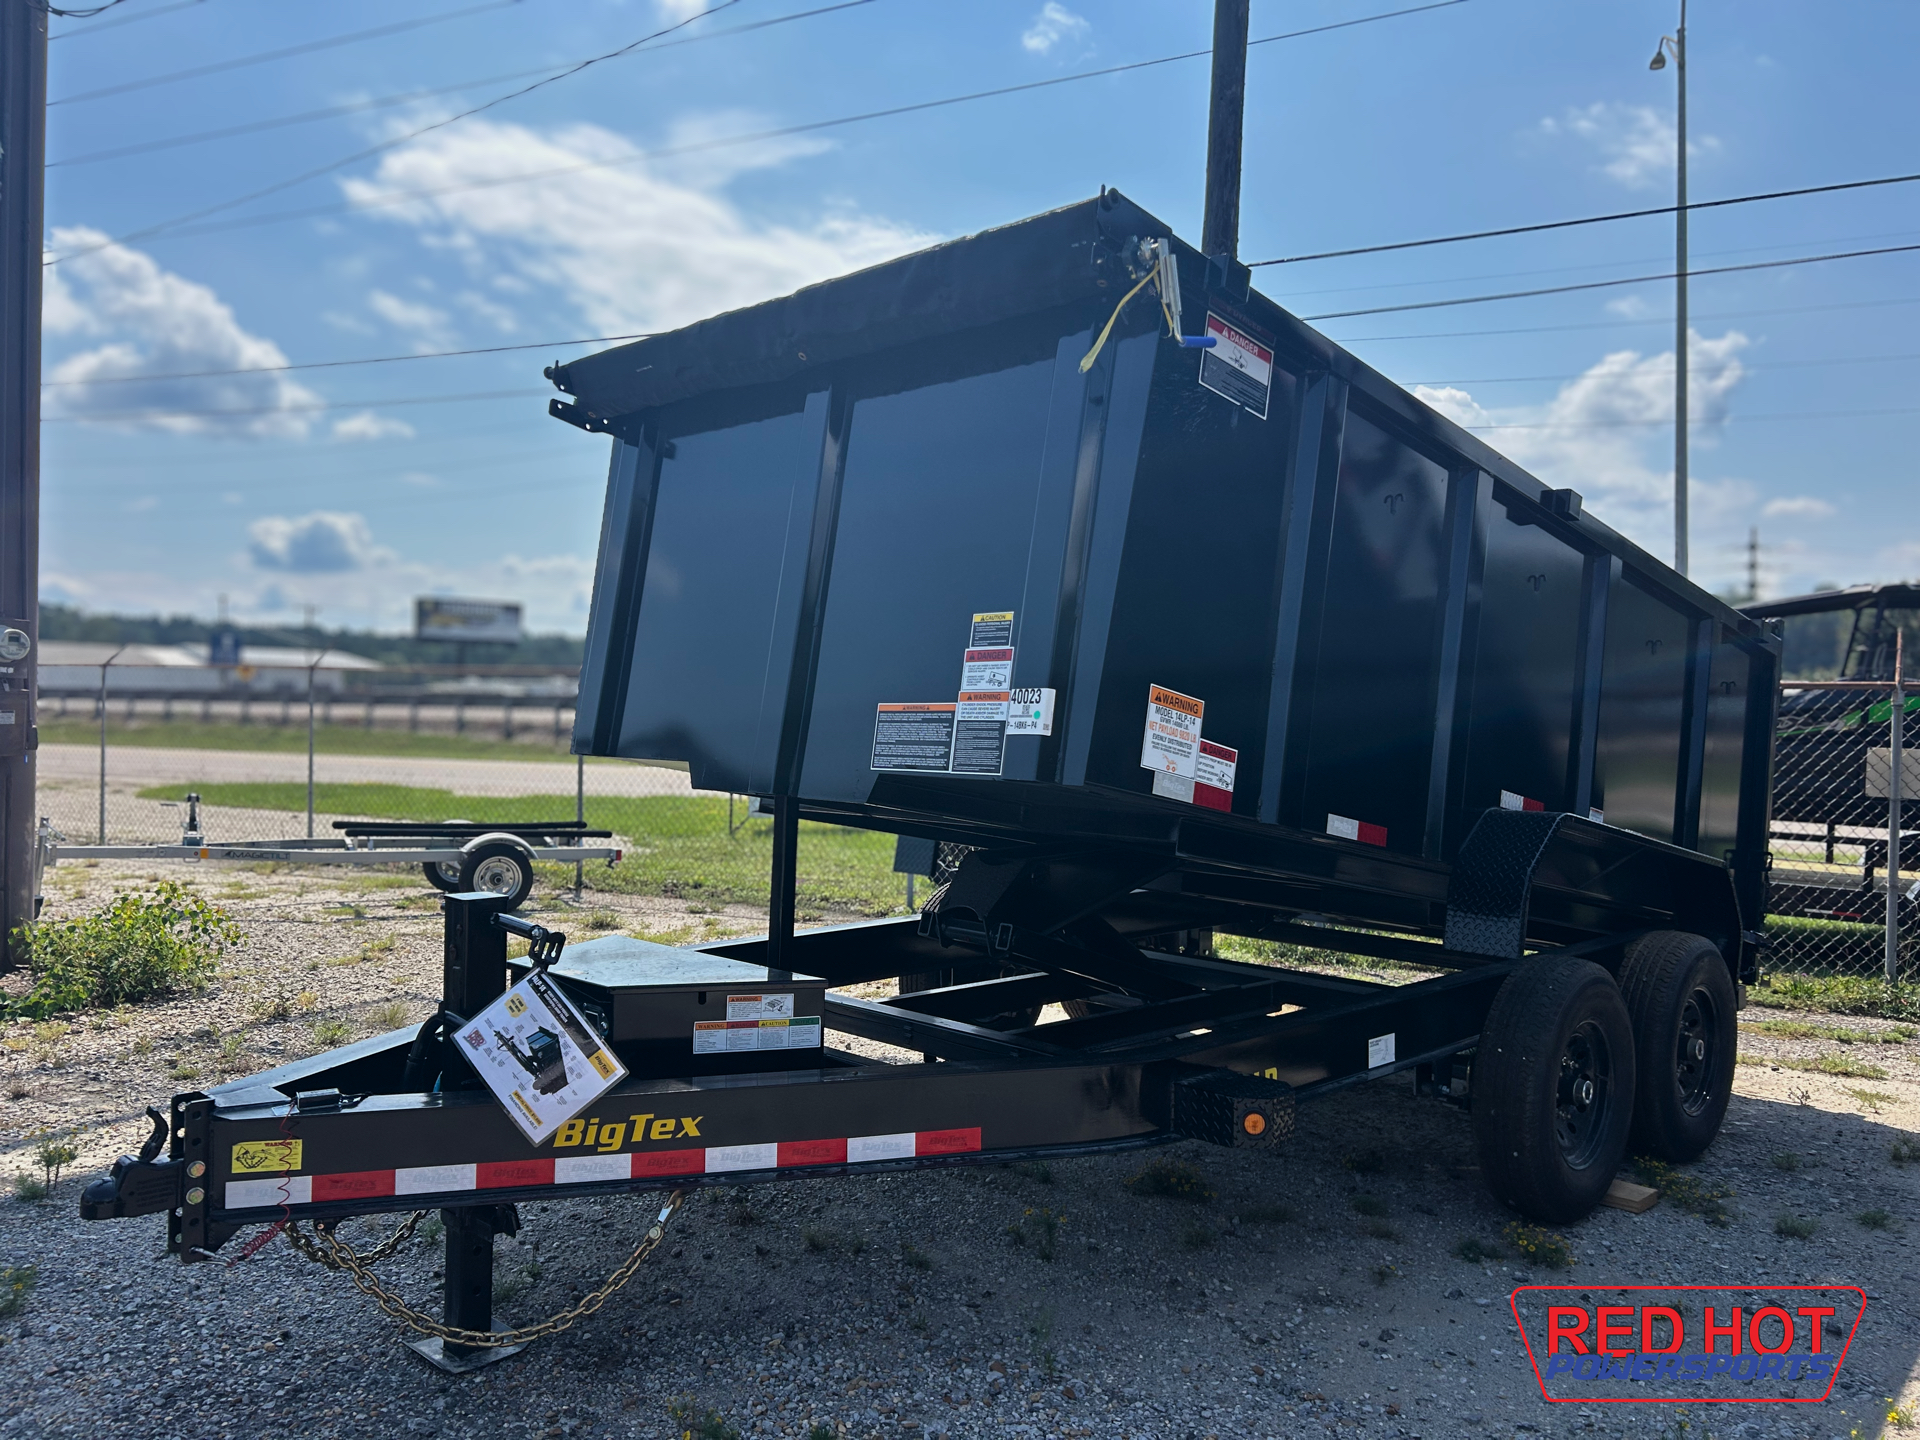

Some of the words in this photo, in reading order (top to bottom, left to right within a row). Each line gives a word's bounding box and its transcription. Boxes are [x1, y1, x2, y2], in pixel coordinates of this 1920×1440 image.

[1230, 331, 1259, 356] DANGER
[977, 651, 1006, 660] DANGER
[1011, 688, 1042, 704] 40023
[1162, 693, 1198, 714] WARNING
[1155, 706, 1174, 719] MODEL
[1175, 712, 1196, 726] 14LP-14
[1160, 717, 1171, 725] GVWR
[1148, 721, 1157, 731] NET
[1158, 723, 1178, 738] PAYLOAD
[1152, 733, 1167, 743] EVENLY
[1167, 737, 1192, 750] DISTRIBUTED
[1209, 746, 1232, 759] DANGER
[232, 852, 290, 860] MAGICTILT
[467, 1034, 480, 1048] HOT
[474, 1030, 484, 1043] RED
[595, 1056, 610, 1074] BigTex
[552, 1113, 704, 1152] BigTex
